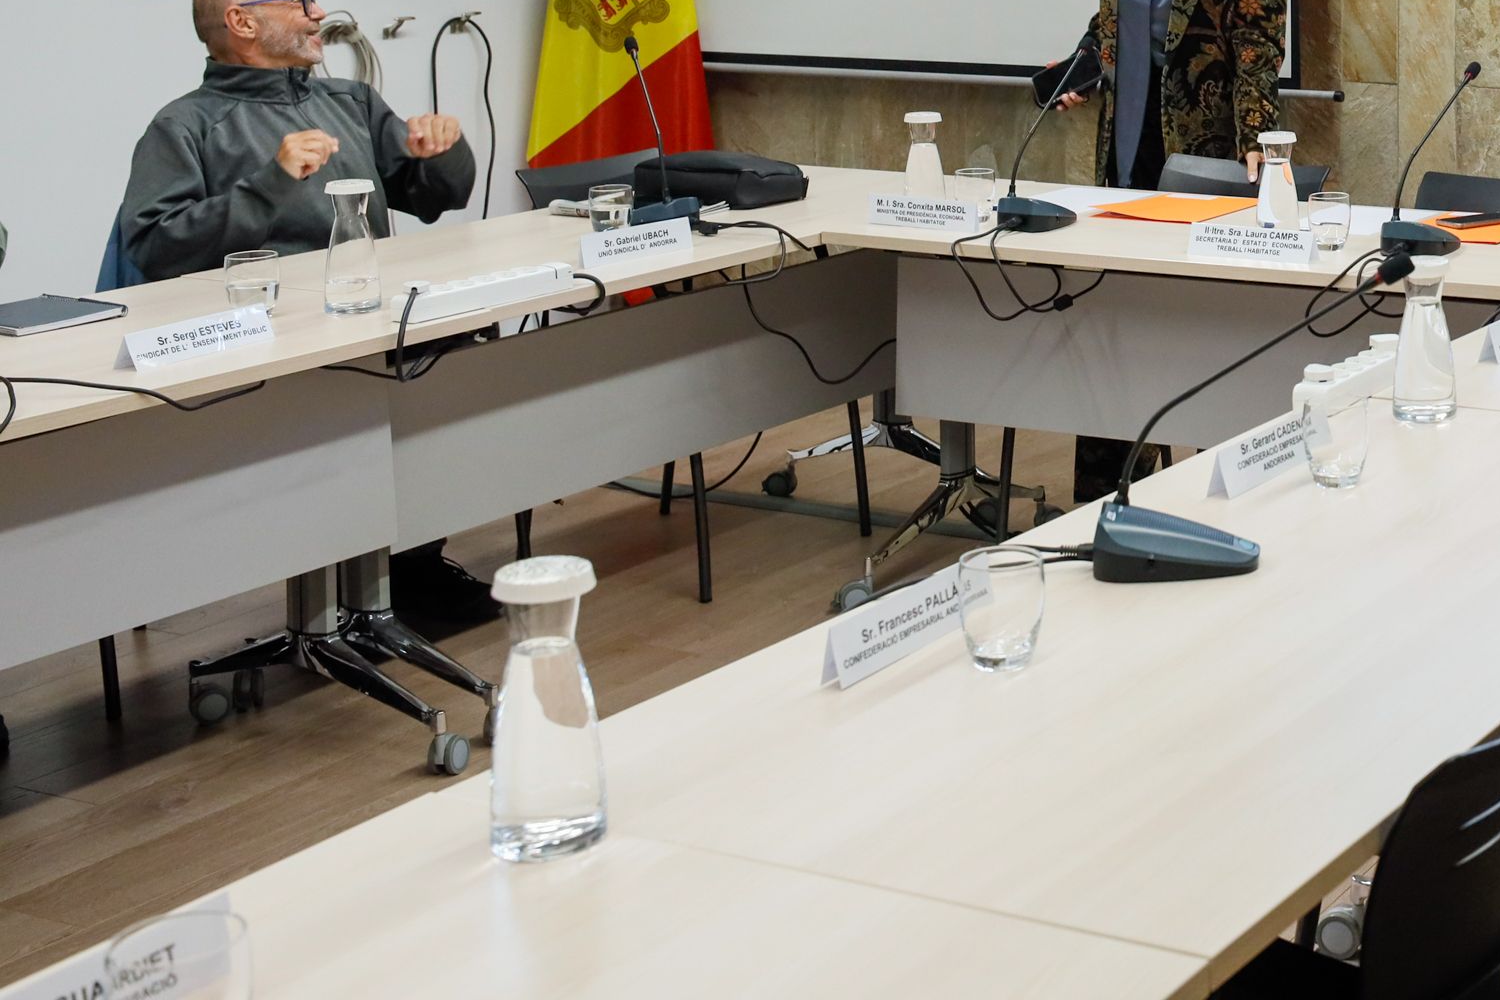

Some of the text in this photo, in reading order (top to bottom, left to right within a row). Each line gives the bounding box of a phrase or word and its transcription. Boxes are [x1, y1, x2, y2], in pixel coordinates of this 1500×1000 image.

[877, 199, 885, 207] M.
[892, 200, 906, 209] Sra.
[907, 201, 934, 211] Conxita
[935, 204, 967, 214] MARSOL
[604, 229, 669, 248] Sr. Gabriel UBACH
[1228, 228, 1243, 237] Sra.
[1245, 229, 1268, 239] Laura
[1269, 231, 1299, 241] CAMPS
[1242, 239, 1262, 247] ESTAT
[614, 244, 639, 255] SINDICAL
[649, 238, 678, 248] ANDORRA
[1217, 245, 1243, 253] TREBALL
[1247, 247, 1280, 256] HABITATGE
[157, 320, 242, 346] Sr. Sergi ESTEVES
[171, 345, 182, 354] DE
[1240, 443, 1251, 455] Sr.
[1252, 431, 1277, 450] Gerard
[1237, 445, 1279, 471] CONFEDERACIÓ
[1263, 450, 1295, 471] ANDORRANA
[861, 627, 878, 644] Sr.
[878, 605, 924, 636] Francesc
[843, 633, 899, 670] CONFEDERACIÓ
[899, 611, 945, 643] EMPRESARIAL
